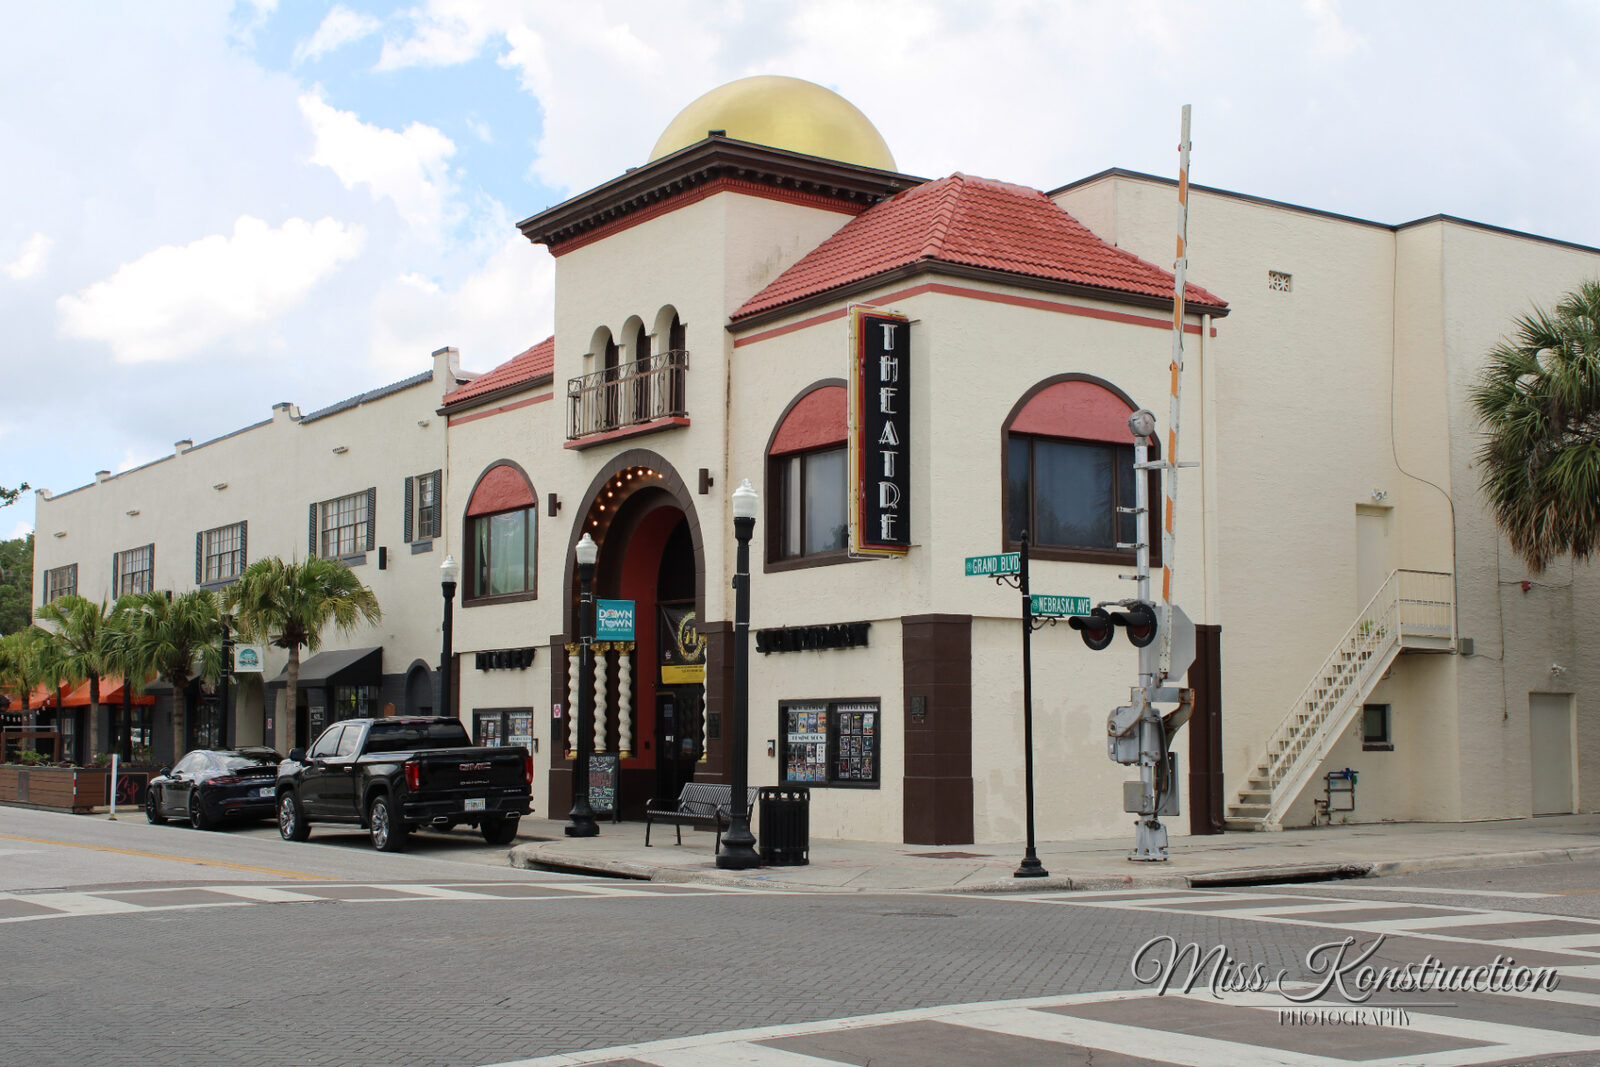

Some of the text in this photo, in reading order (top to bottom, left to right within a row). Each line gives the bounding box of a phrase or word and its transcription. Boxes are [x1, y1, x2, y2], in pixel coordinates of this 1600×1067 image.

[878, 323, 901, 541] THEATRE
[972, 555, 1019, 574] GRAND BLVD
[1039, 597, 1090, 614] NEBRASKA AVE
[599, 609, 632, 618] DOWN
[599, 618, 632, 628] TOWN
[459, 762, 492, 771] GMC
